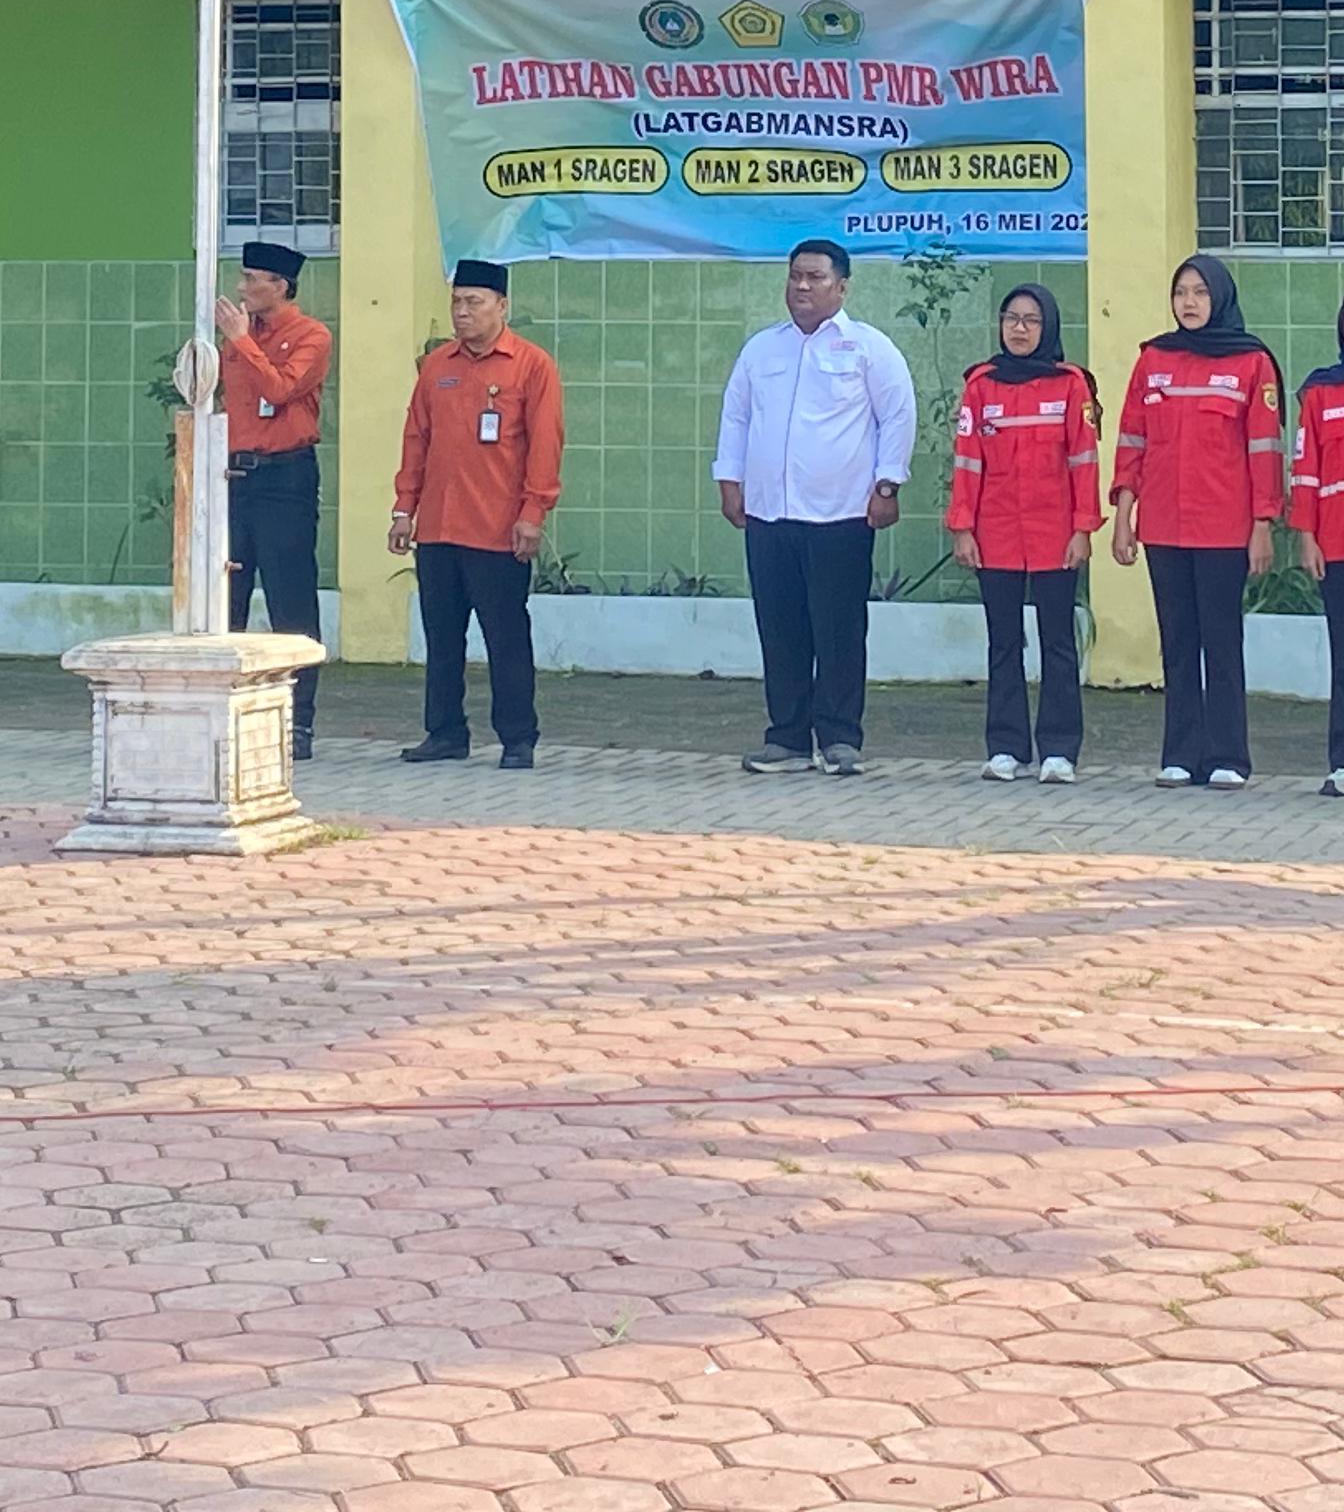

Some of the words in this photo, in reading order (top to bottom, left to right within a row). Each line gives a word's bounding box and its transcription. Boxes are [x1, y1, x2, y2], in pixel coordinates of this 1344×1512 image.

[472, 59, 637, 105] LATIHAN
[646, 61, 852, 101] GABUNGAN
[860, 61, 945, 106] PMR
[950, 54, 1060, 102] WIRA
[633, 111, 909, 145] (LATGABMANSRA)
[497, 160, 546, 188] MAN
[554, 159, 563, 182] 1
[571, 157, 657, 183] SRAGEN
[695, 159, 742, 185] MAN
[748, 159, 759, 184] 2
[767, 158, 855, 184] SRAGEN
[893, 155, 942, 181] MAN
[949, 154, 961, 180] 3
[968, 152, 1058, 179] SRAGEN
[847, 214, 952, 236] PLUPUH,
[962, 213, 989, 232] 16
[998, 214, 1041, 232] MEI
